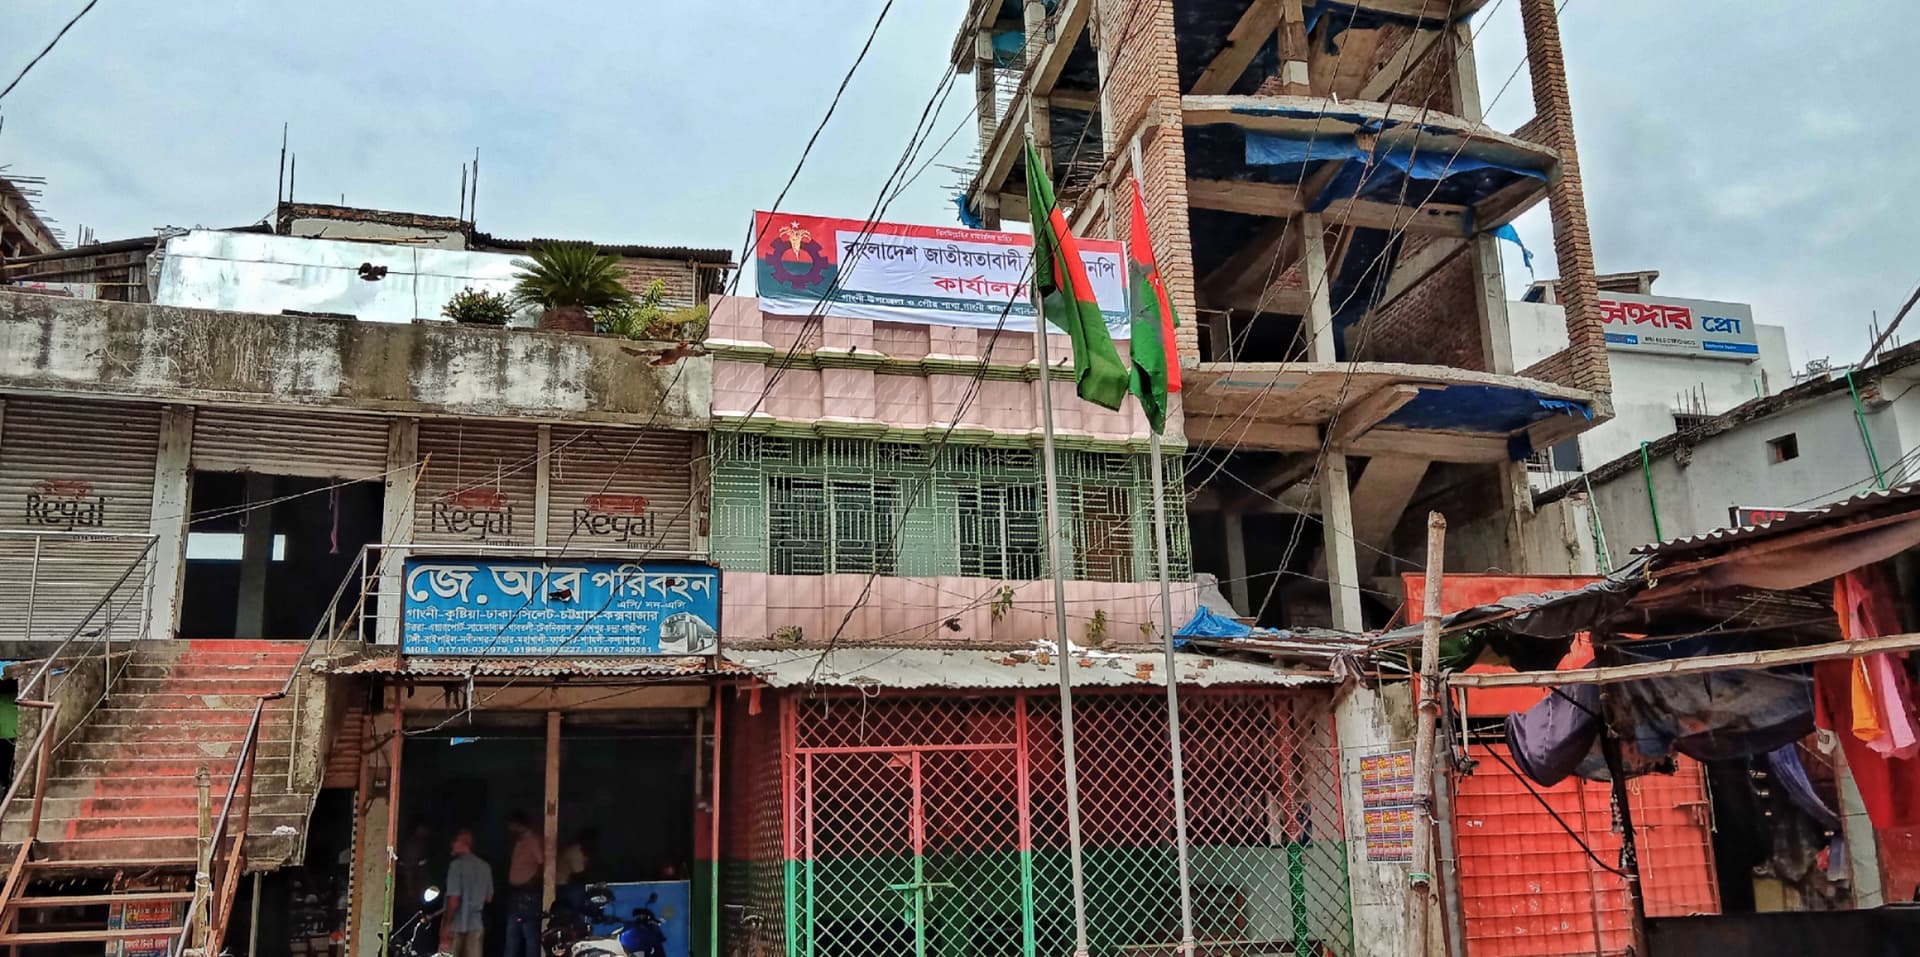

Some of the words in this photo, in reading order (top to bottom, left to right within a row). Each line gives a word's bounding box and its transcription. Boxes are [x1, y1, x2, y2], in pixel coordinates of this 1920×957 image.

[842, 241, 918, 263] বাংলাদেশ
[923, 244, 1025, 271] জাতীয়তাবাদী
[1701, 315, 1741, 334] প্রো
[27, 495, 104, 532] Regal
[431, 501, 512, 540] Regal
[573, 508, 654, 541] Regal
[591, 563, 716, 603] পরিবহন
